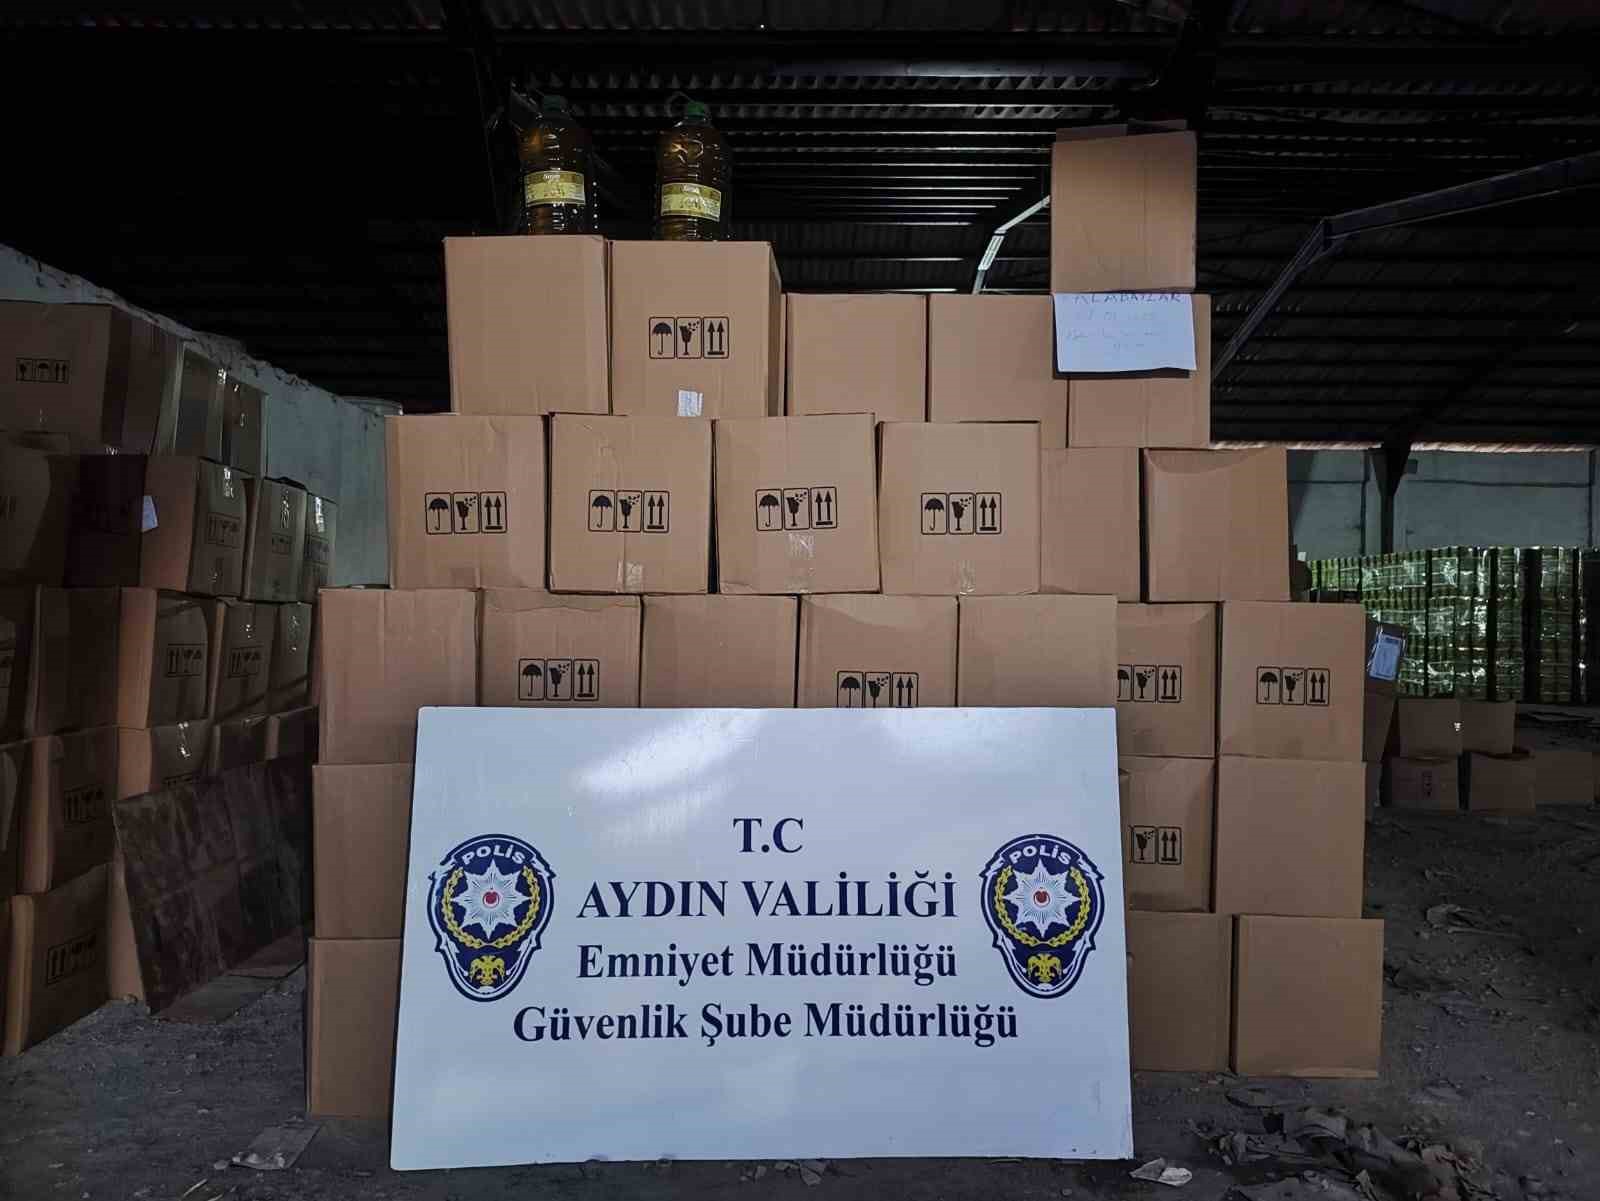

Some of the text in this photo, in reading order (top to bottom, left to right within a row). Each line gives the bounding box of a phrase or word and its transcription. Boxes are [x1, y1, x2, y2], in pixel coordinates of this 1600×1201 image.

[733, 818, 804, 853] T.C
[577, 870, 958, 918] AYDIN VALİLİĞİ
[577, 942, 957, 987] Emniyet Müdürlüğü
[513, 1002, 1018, 1048] Güvenlik Şube Müdürlüğü
